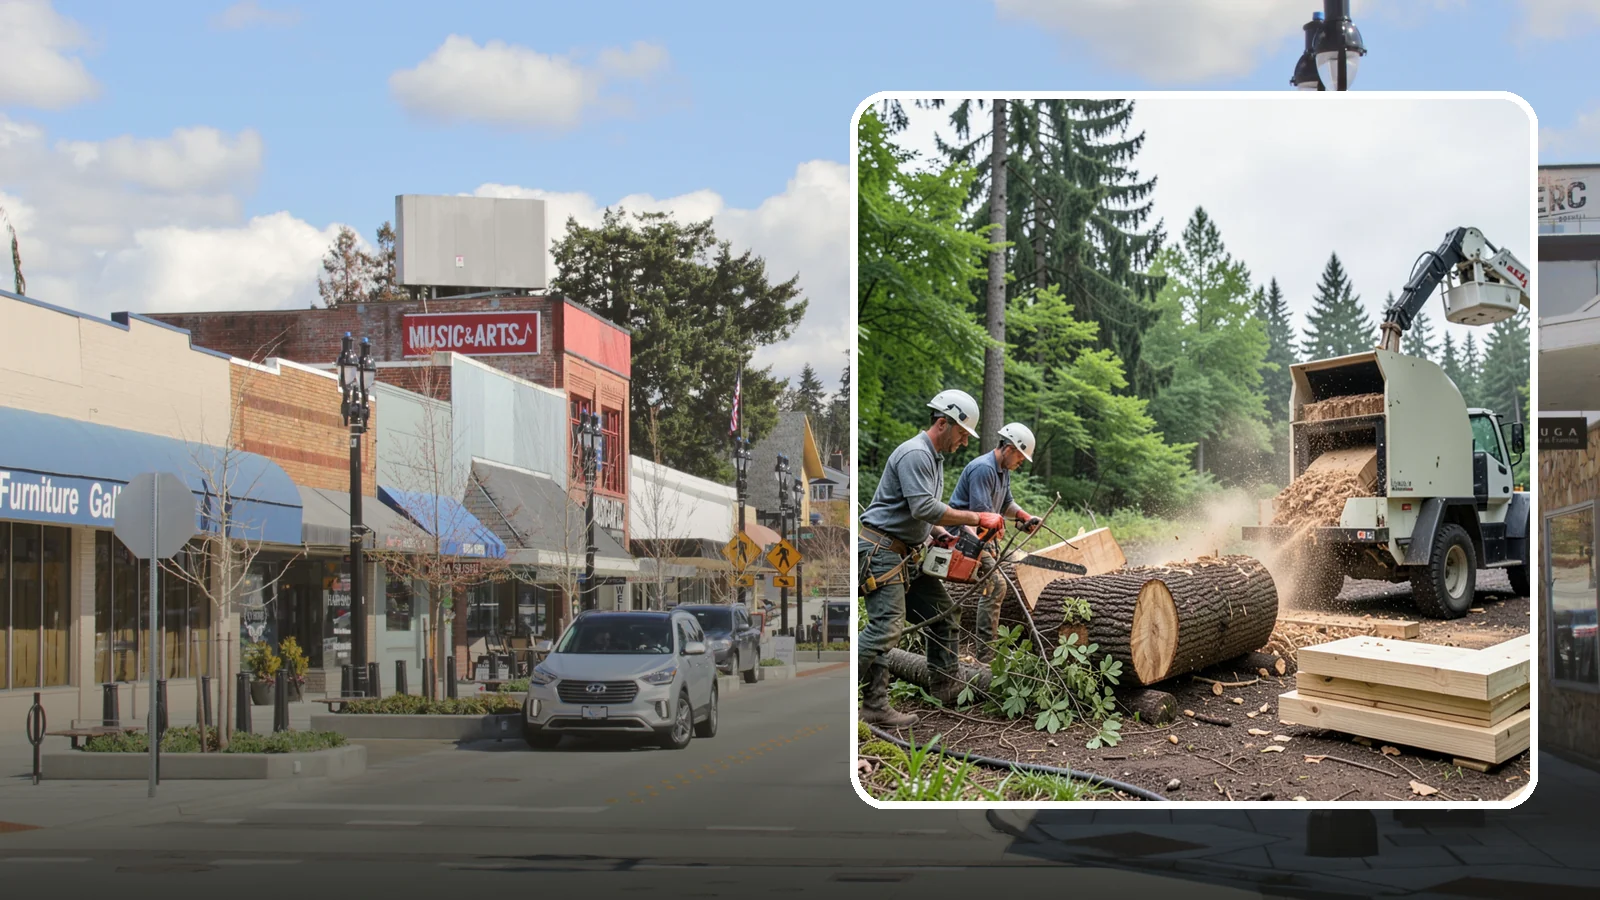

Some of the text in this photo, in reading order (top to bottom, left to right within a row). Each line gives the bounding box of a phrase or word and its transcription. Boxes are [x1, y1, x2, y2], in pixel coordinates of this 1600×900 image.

[408, 322, 519, 349] MUSIC&ARTS
[1540, 427, 1577, 436] UGA
[0, 471, 79, 515] Furniture
[453, 563, 479, 574] SUSHI
